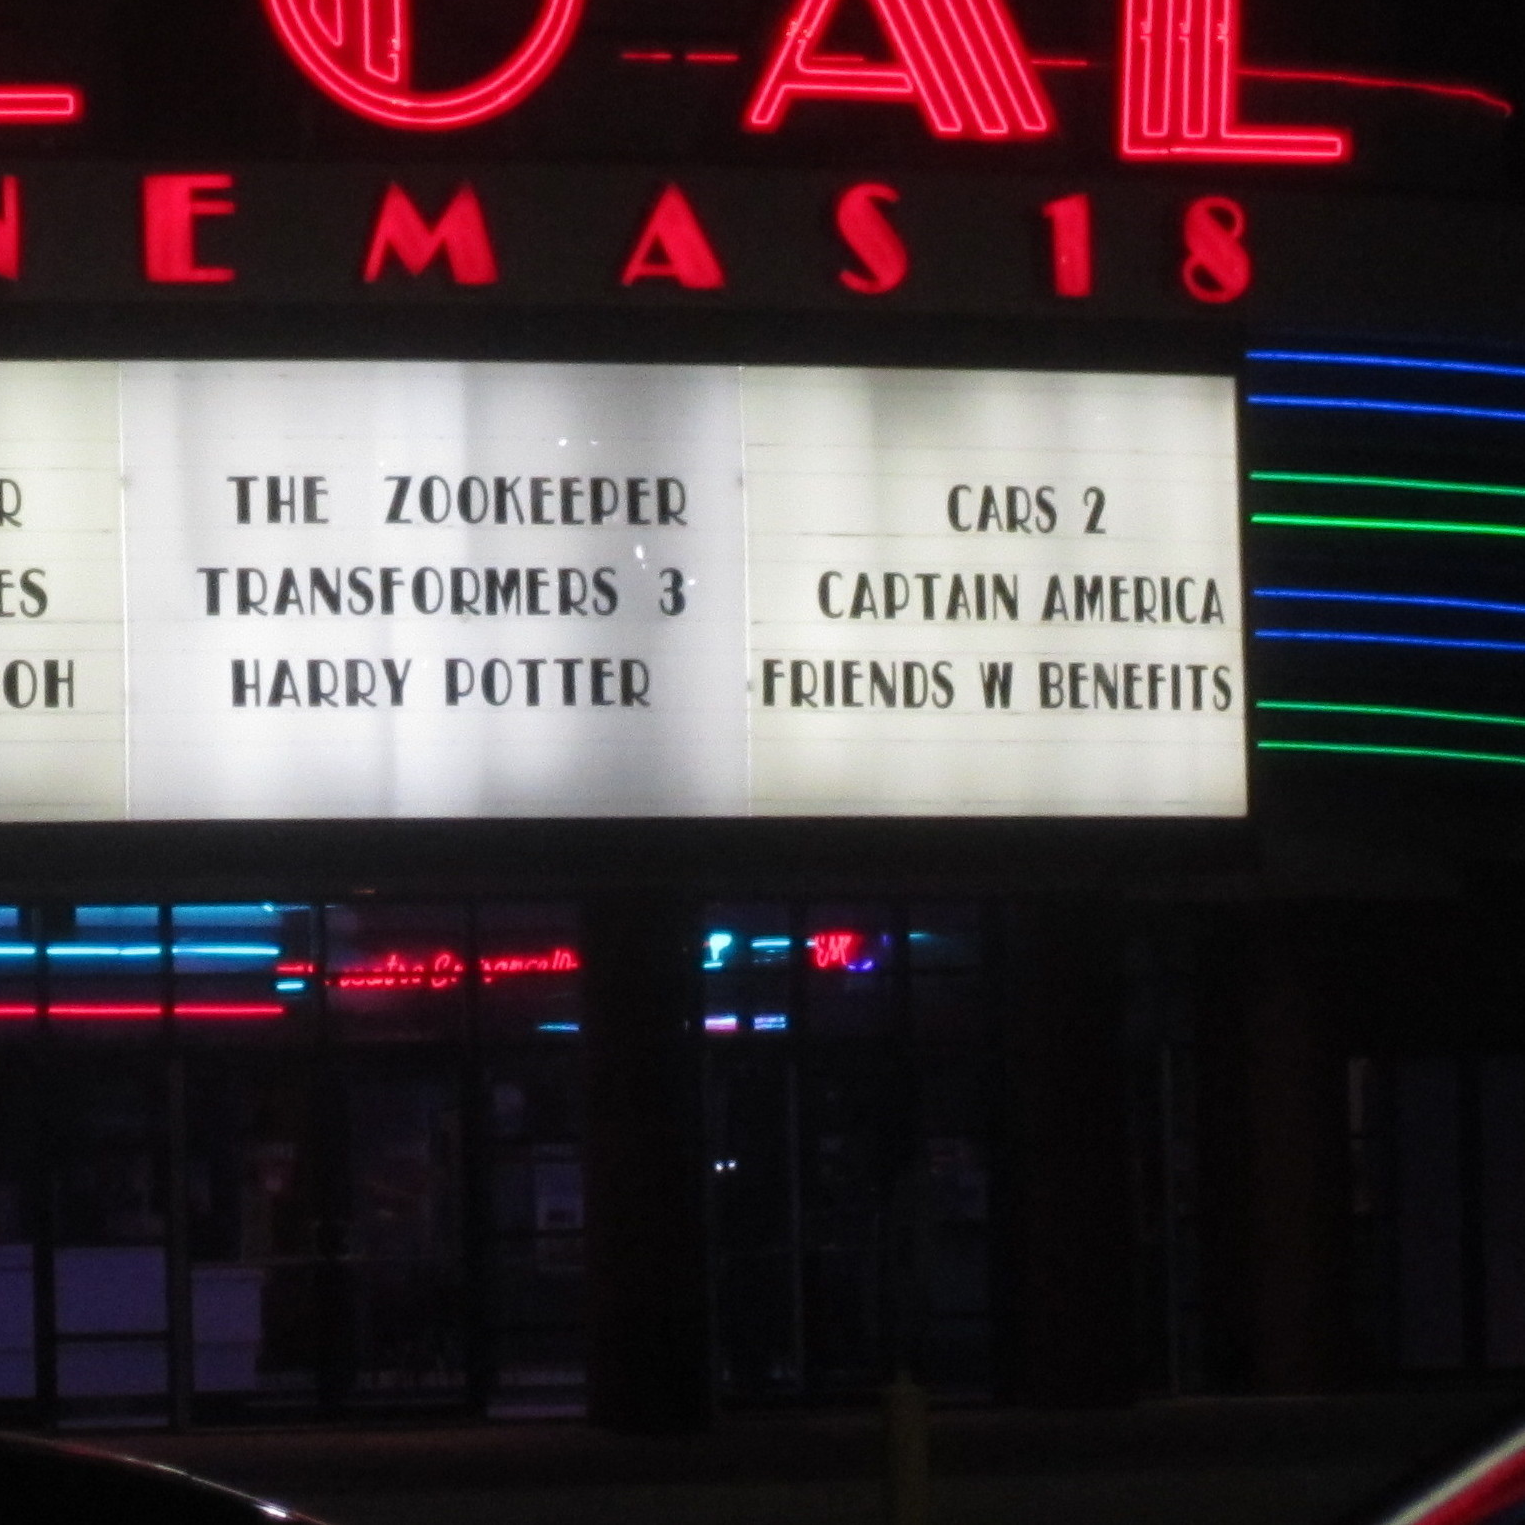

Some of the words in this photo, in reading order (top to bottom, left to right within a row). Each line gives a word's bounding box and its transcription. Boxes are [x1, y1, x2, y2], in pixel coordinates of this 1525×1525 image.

[1041, 193, 1252, 303] 18
[227, 475, 330, 525] THE
[384, 475, 688, 526] ZOOKEEPER
[946, 484, 1058, 534] CARS
[1083, 486, 1107, 534] 2
[196, 566, 619, 617] TRANSFORMERS
[658, 566, 686, 617] 3
[817, 571, 1019, 621] CAPTAIN
[1040, 575, 1225, 624] AMERICA
[230, 658, 412, 707] HARRY
[444, 658, 652, 707] POTTER
[761, 659, 956, 709] FRIENDS
[979, 661, 1014, 709] W
[1037, 662, 1233, 712] BENEFITS
